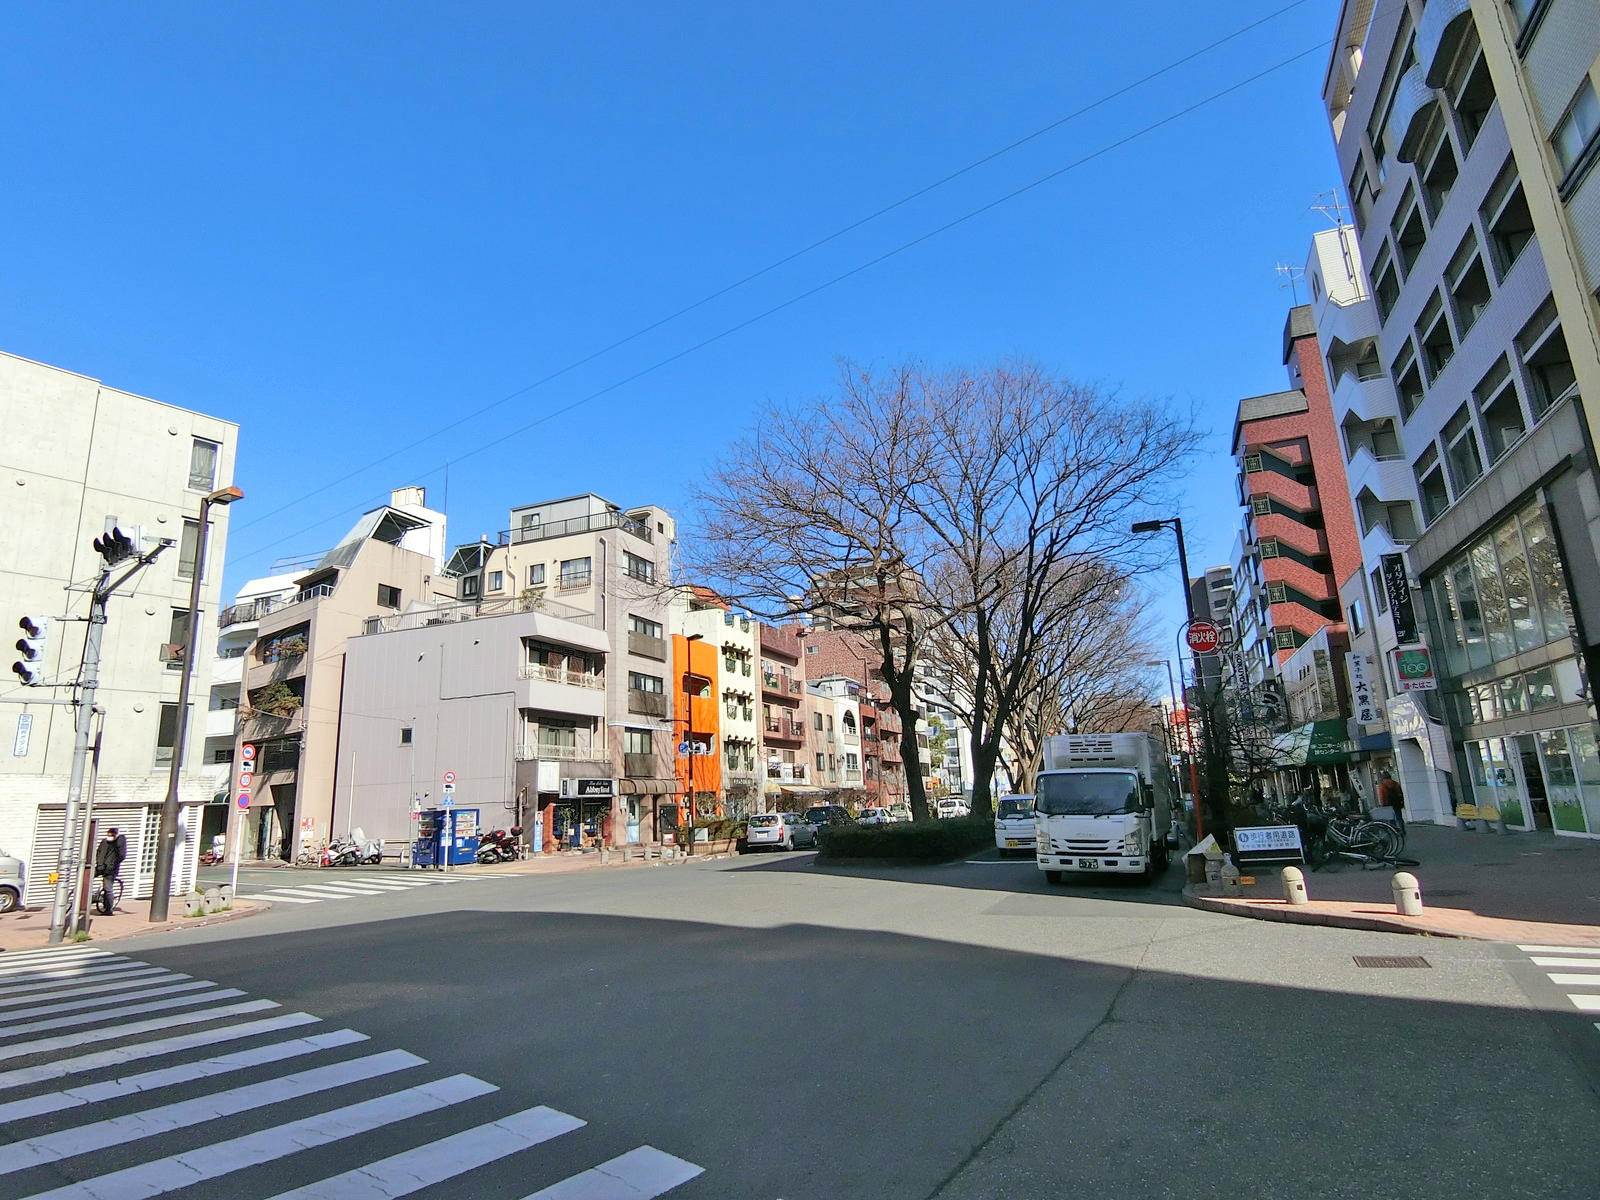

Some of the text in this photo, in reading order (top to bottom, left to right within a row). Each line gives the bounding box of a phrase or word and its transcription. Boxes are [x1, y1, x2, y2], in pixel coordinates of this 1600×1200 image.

[1394, 563, 1409, 604] オタケイジ
[1188, 631, 1217, 644] 消火栓
[1355, 681, 1373, 721] 大黒屋
[1250, 831, 1296, 841] 歩行者用道路
